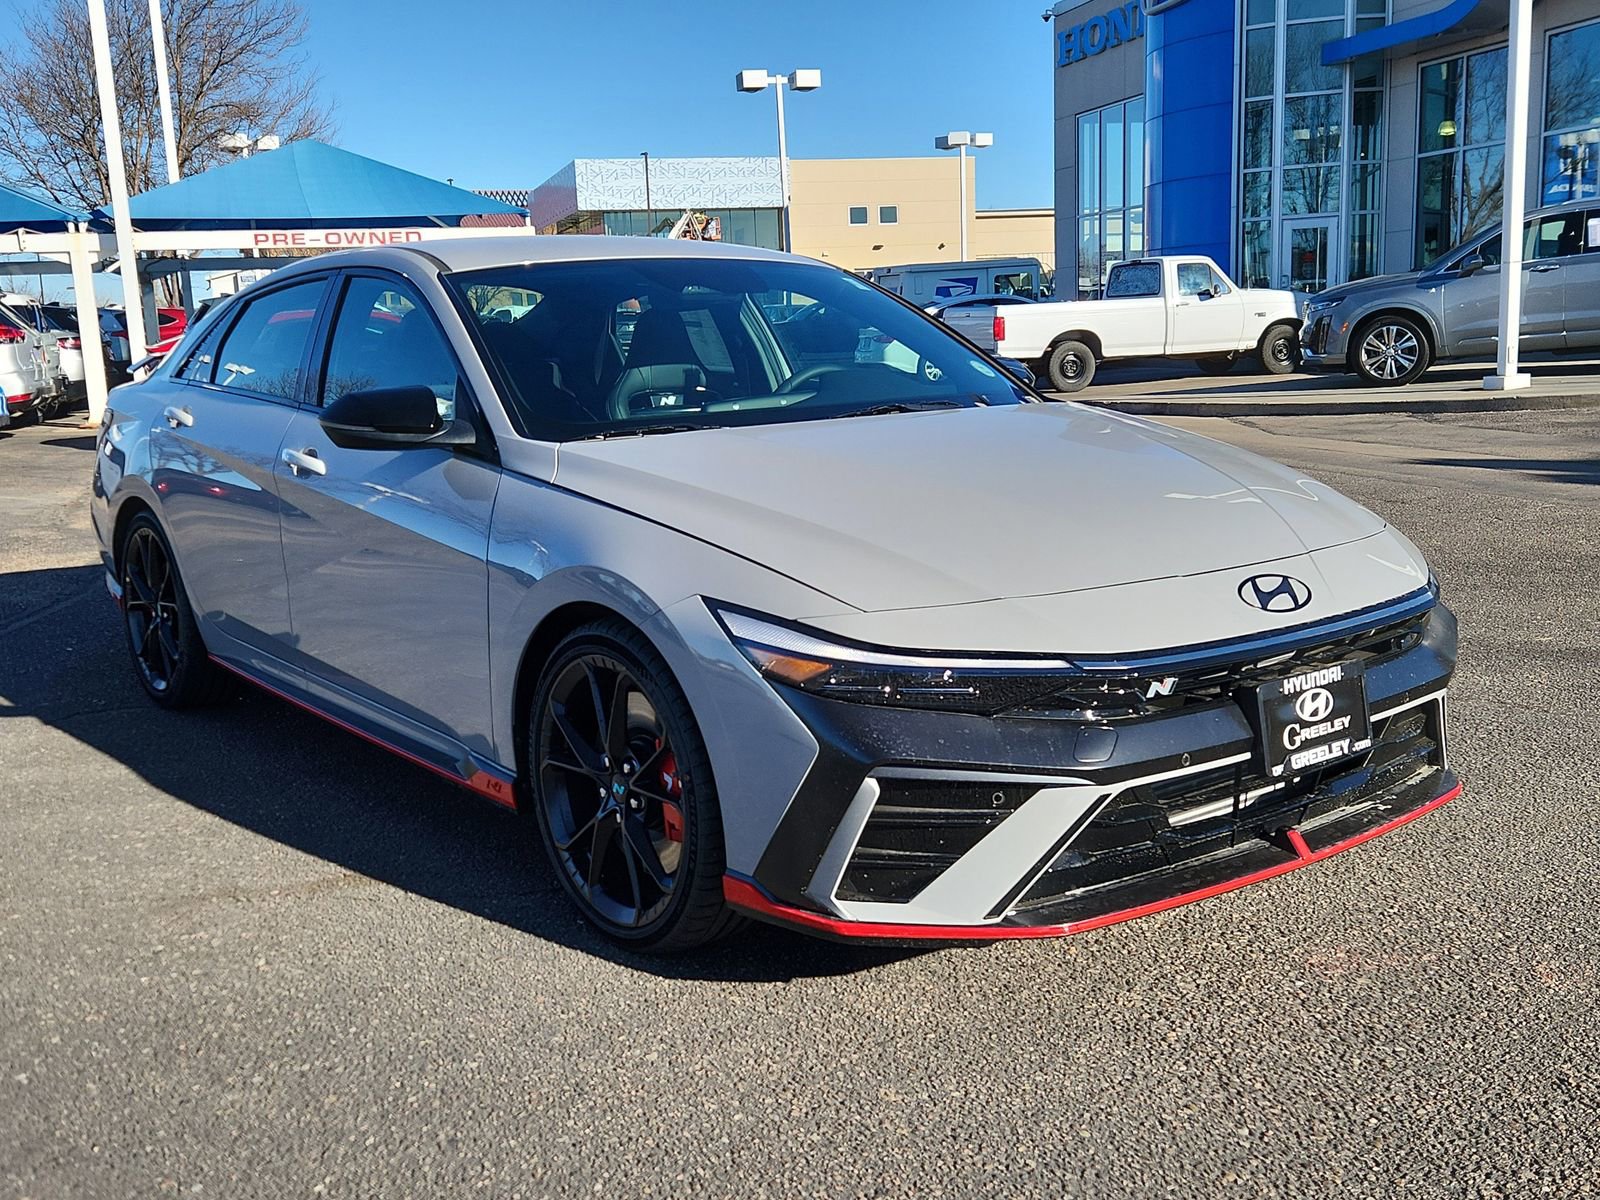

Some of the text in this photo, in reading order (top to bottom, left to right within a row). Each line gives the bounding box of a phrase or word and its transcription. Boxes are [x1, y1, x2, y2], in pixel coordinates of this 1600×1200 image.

[253, 231, 422, 246] PRE-OWNED
[1145, 677, 1179, 699] N
[1283, 665, 1342, 695] HYUNDAI
[1283, 715, 1351, 750] GREELEY
[1290, 738, 1351, 770] GREELEY
